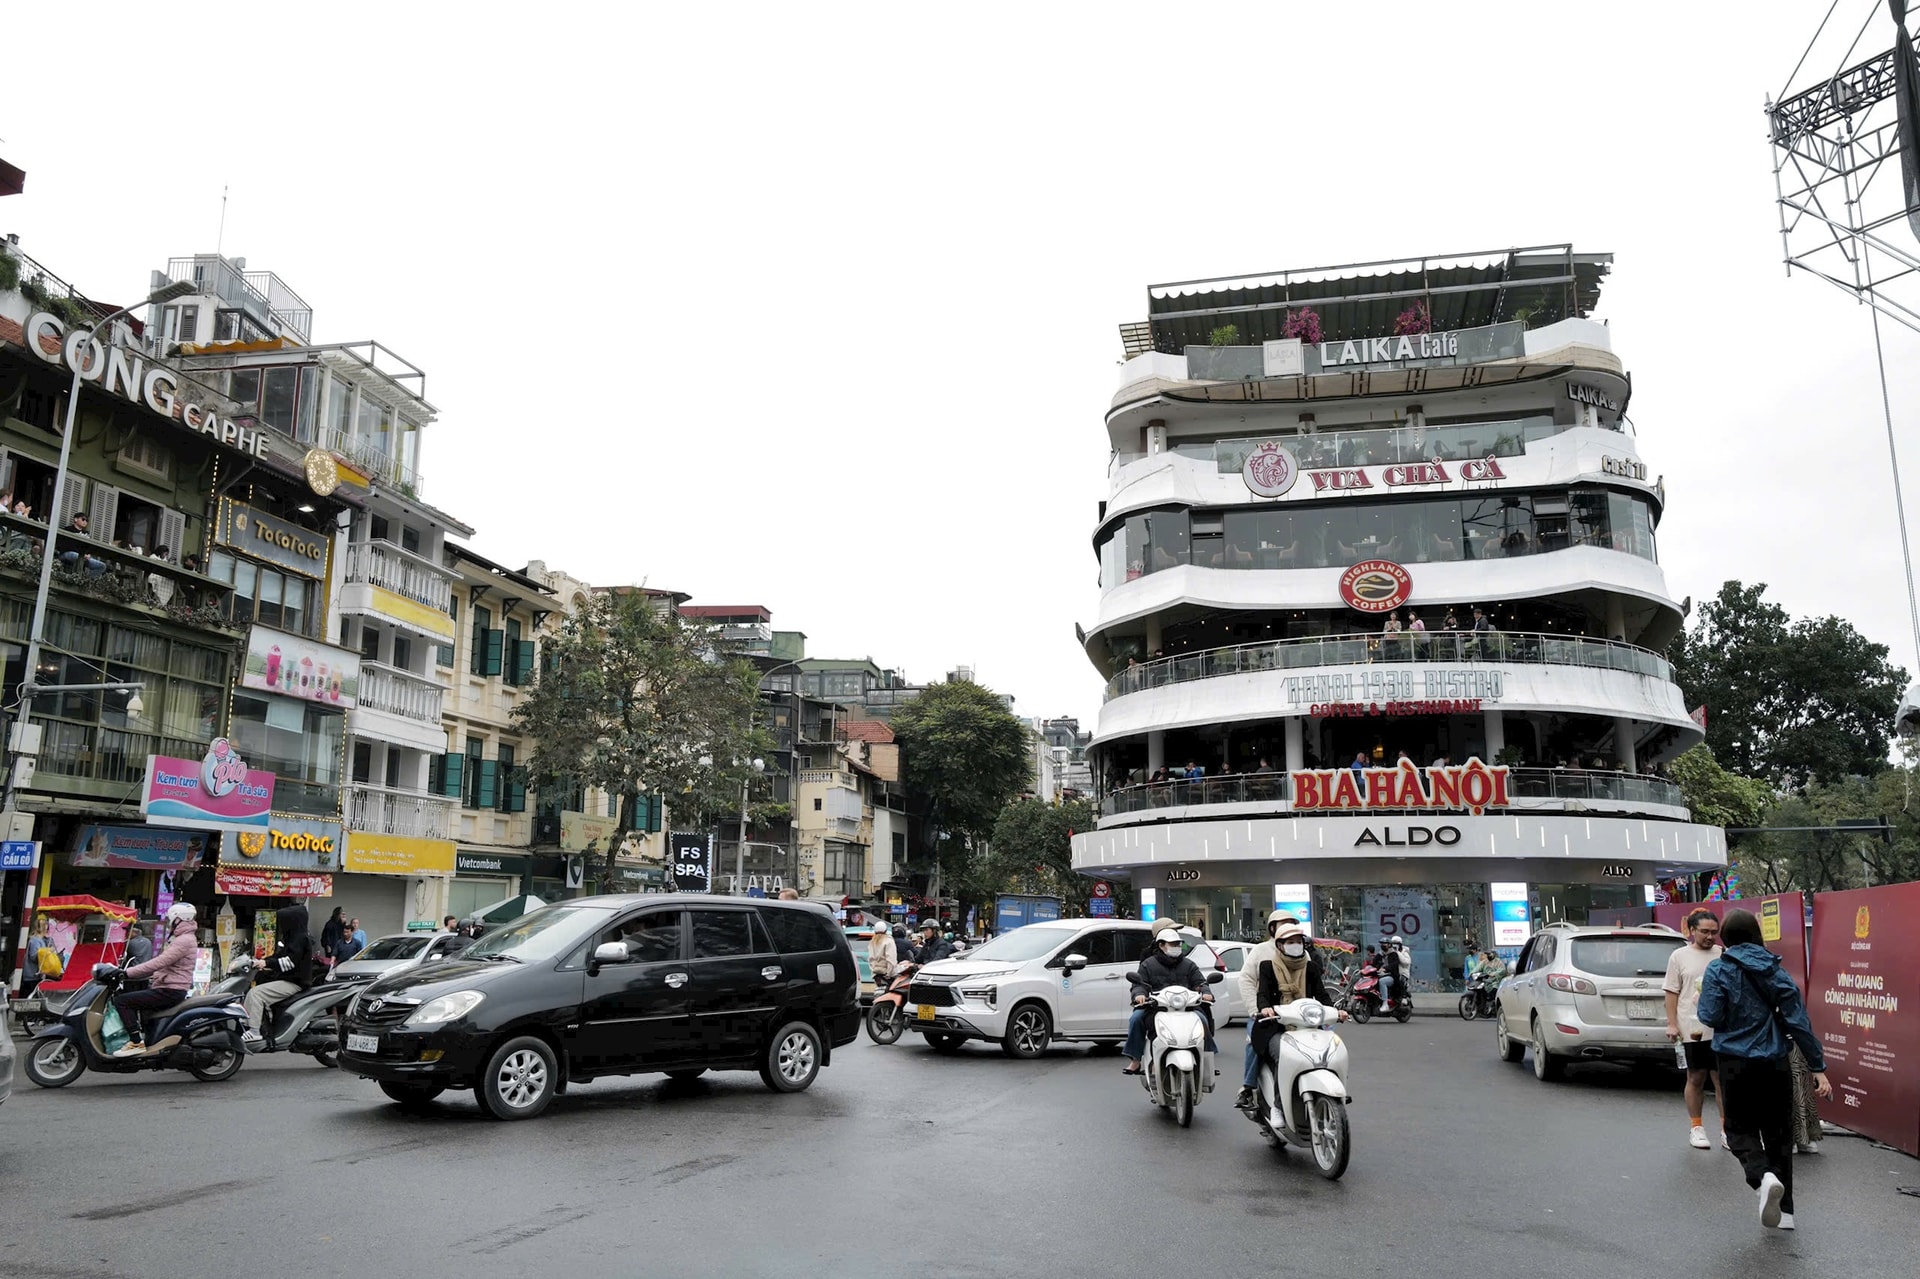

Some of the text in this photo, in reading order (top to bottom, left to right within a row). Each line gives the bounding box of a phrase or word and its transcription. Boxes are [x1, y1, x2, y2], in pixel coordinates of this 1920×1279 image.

[1320, 333, 1458, 366] LAIKA Café
[1567, 382, 1608, 409] LAIKA
[1308, 454, 1507, 490] VUA CHẢ CÁ
[1343, 562, 1408, 586] HIGHLANDS
[1352, 596, 1402, 611] COFFEE
[1283, 670, 1505, 703] HANOI 1930 BISTRO
[1310, 699, 1482, 717] COFFEE & RESTAURANT
[157, 770, 177, 786] Kem
[1292, 758, 1510, 816] BIA HÀ NỘI
[1353, 825, 1462, 847] ALDO
[680, 847, 701, 859] FS
[458, 856, 502, 870] Vietcombank
[675, 864, 706, 876] SPA
[1601, 865, 1633, 878] ALDO
[623, 869, 649, 880] Vietcombank
[1167, 869, 1201, 881] ALDO
[225, 919, 233, 935] 8
[1380, 913, 1420, 935] 50
[1837, 973, 1883, 990] VINH QUANG
[1825, 987, 1898, 1011] CÔNG AN NHÂN DÂN
[1840, 1007, 1875, 1028] VIỆT NAM
